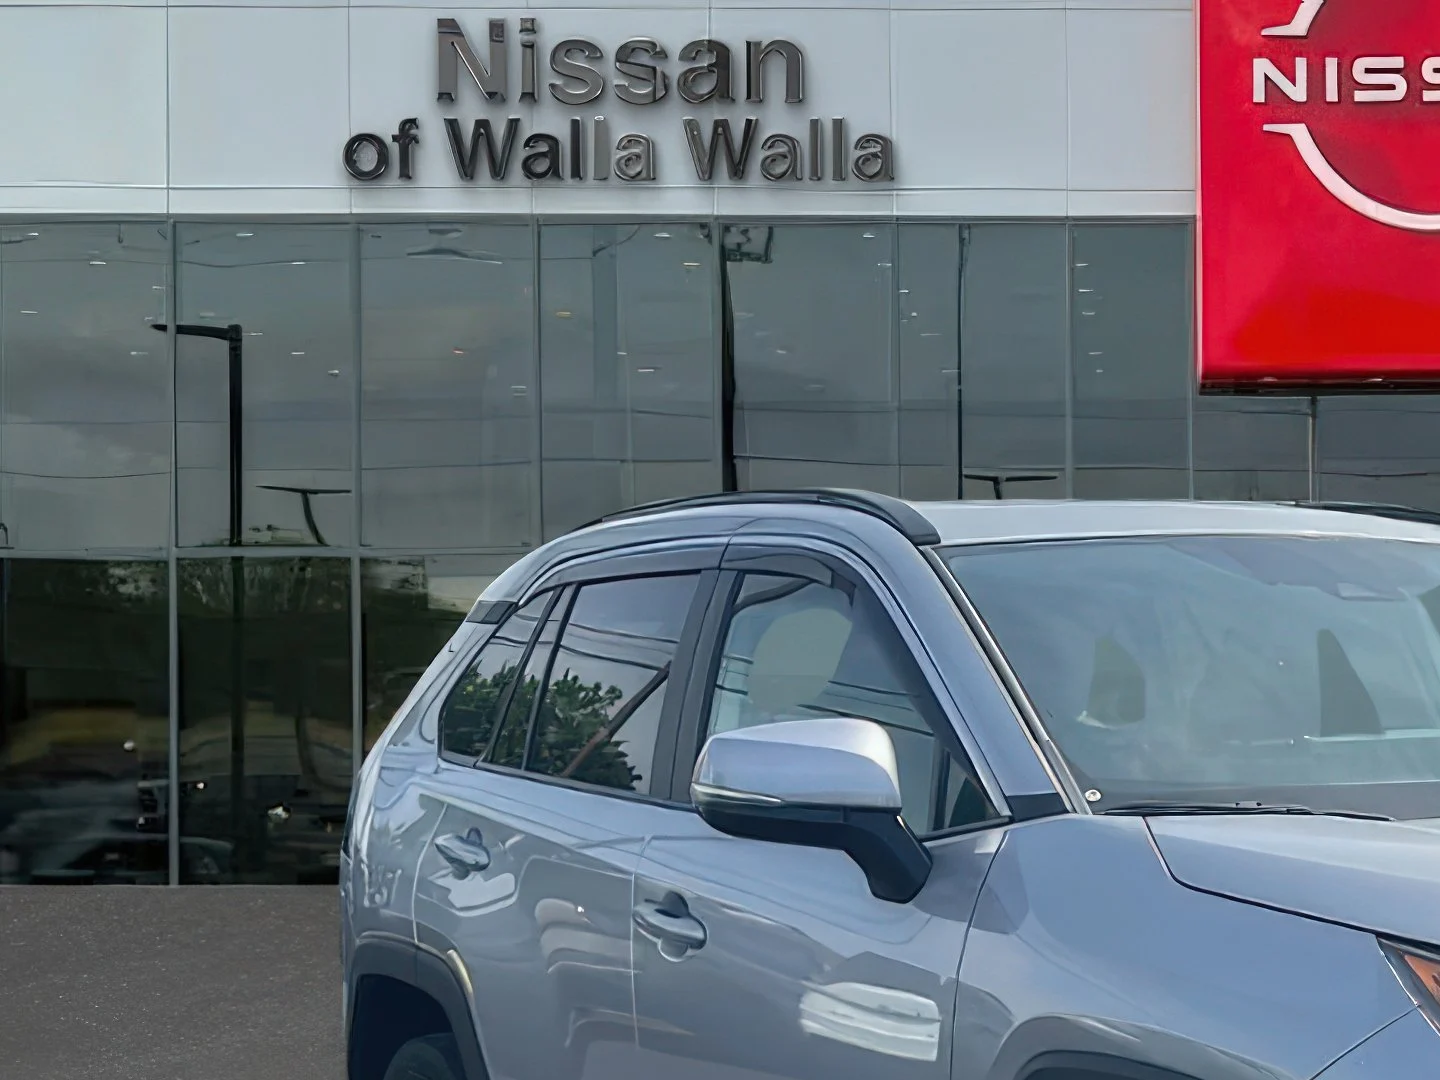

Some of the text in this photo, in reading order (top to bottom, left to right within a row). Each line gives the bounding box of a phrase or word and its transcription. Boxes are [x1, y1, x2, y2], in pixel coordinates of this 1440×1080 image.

[436, 17, 805, 104] Nissan
[342, 116, 895, 181] of Walla Walla
